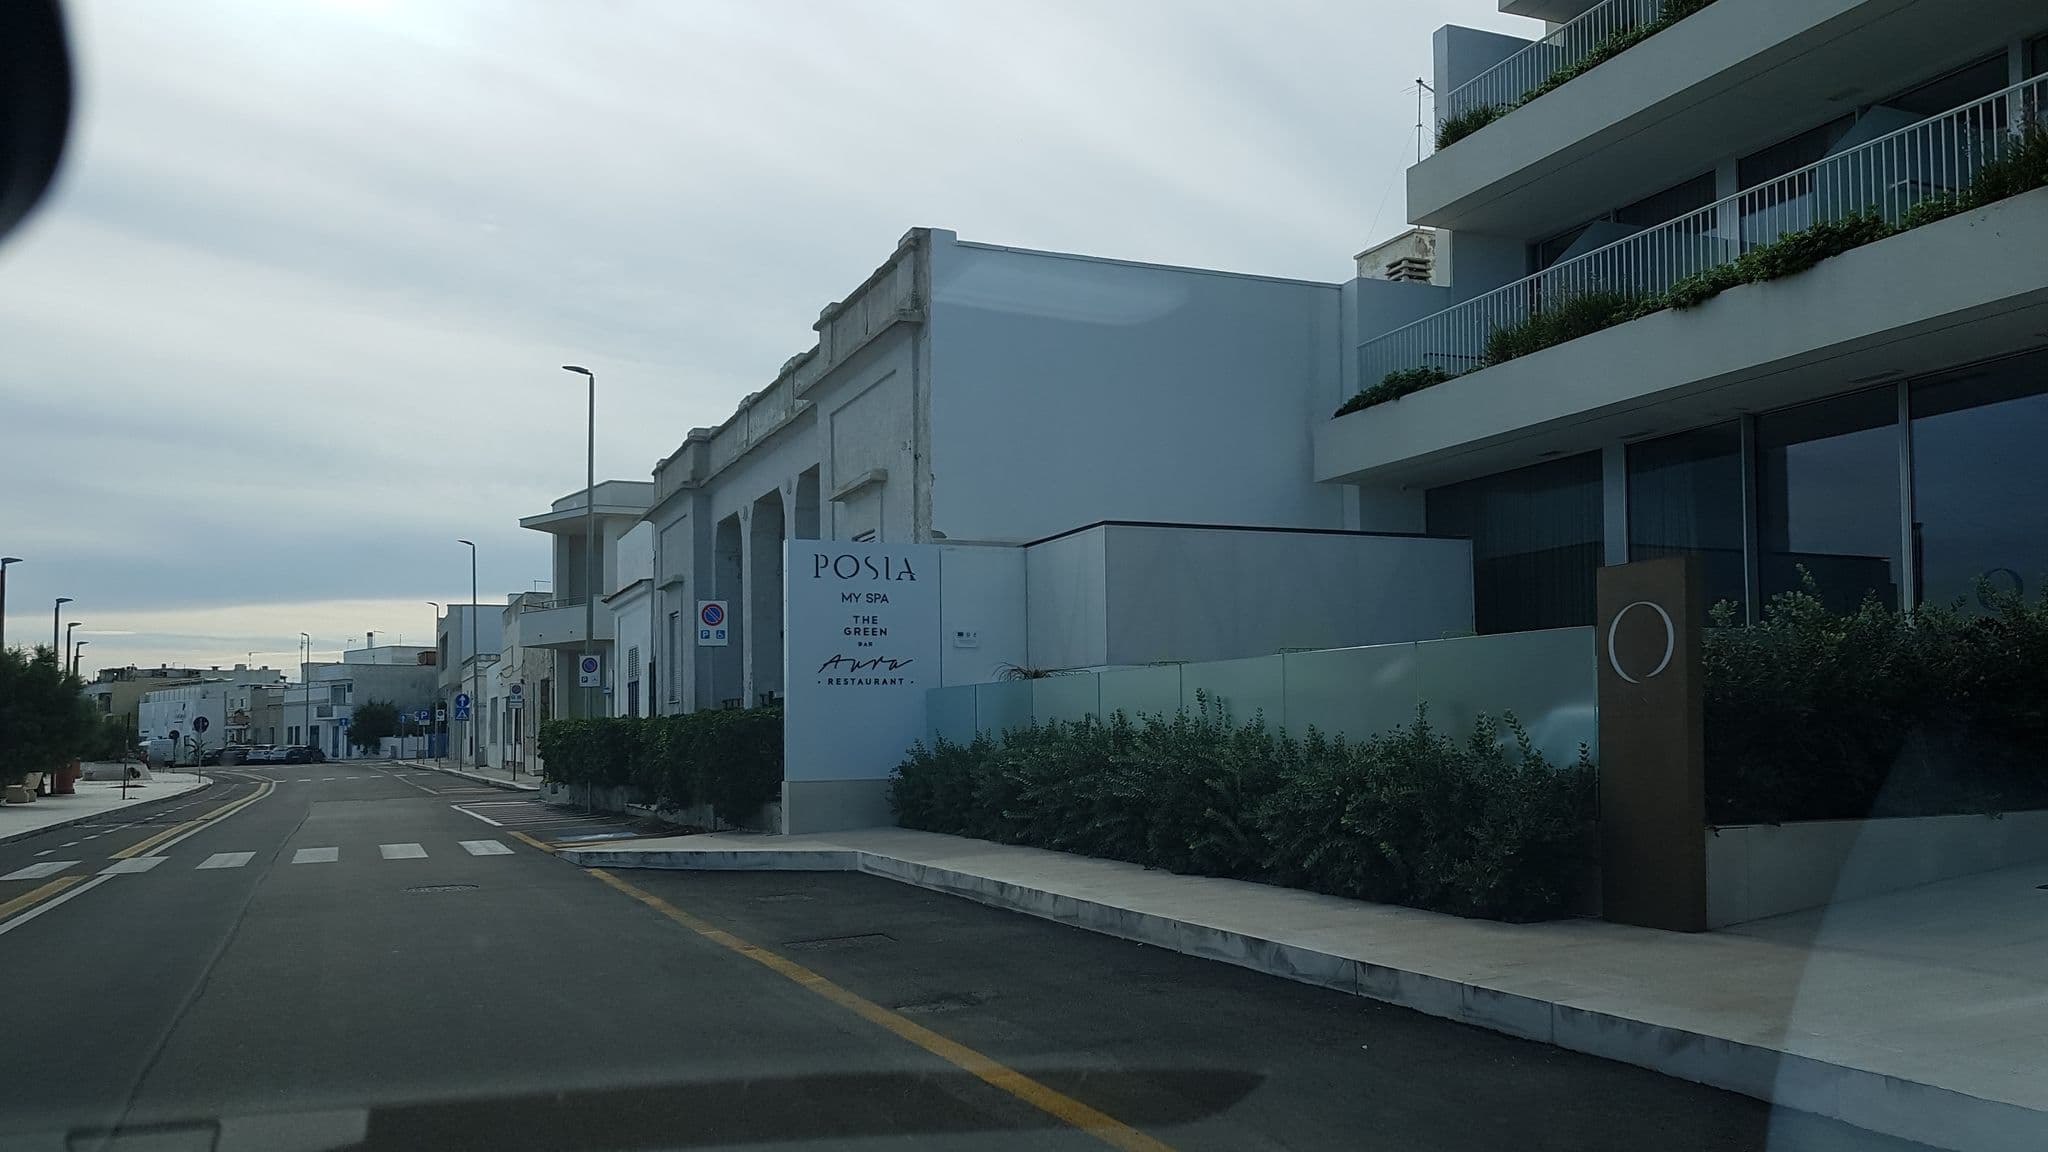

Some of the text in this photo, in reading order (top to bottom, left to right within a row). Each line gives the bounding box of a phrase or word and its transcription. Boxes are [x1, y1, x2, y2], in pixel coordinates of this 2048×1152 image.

[813, 553, 917, 581] POSIA
[841, 592, 890, 604] MY SPA
[852, 615, 879, 625] THE
[843, 627, 888, 636] GREEN
[817, 653, 914, 674] Aura
[827, 677, 905, 686] RESTAURANT
